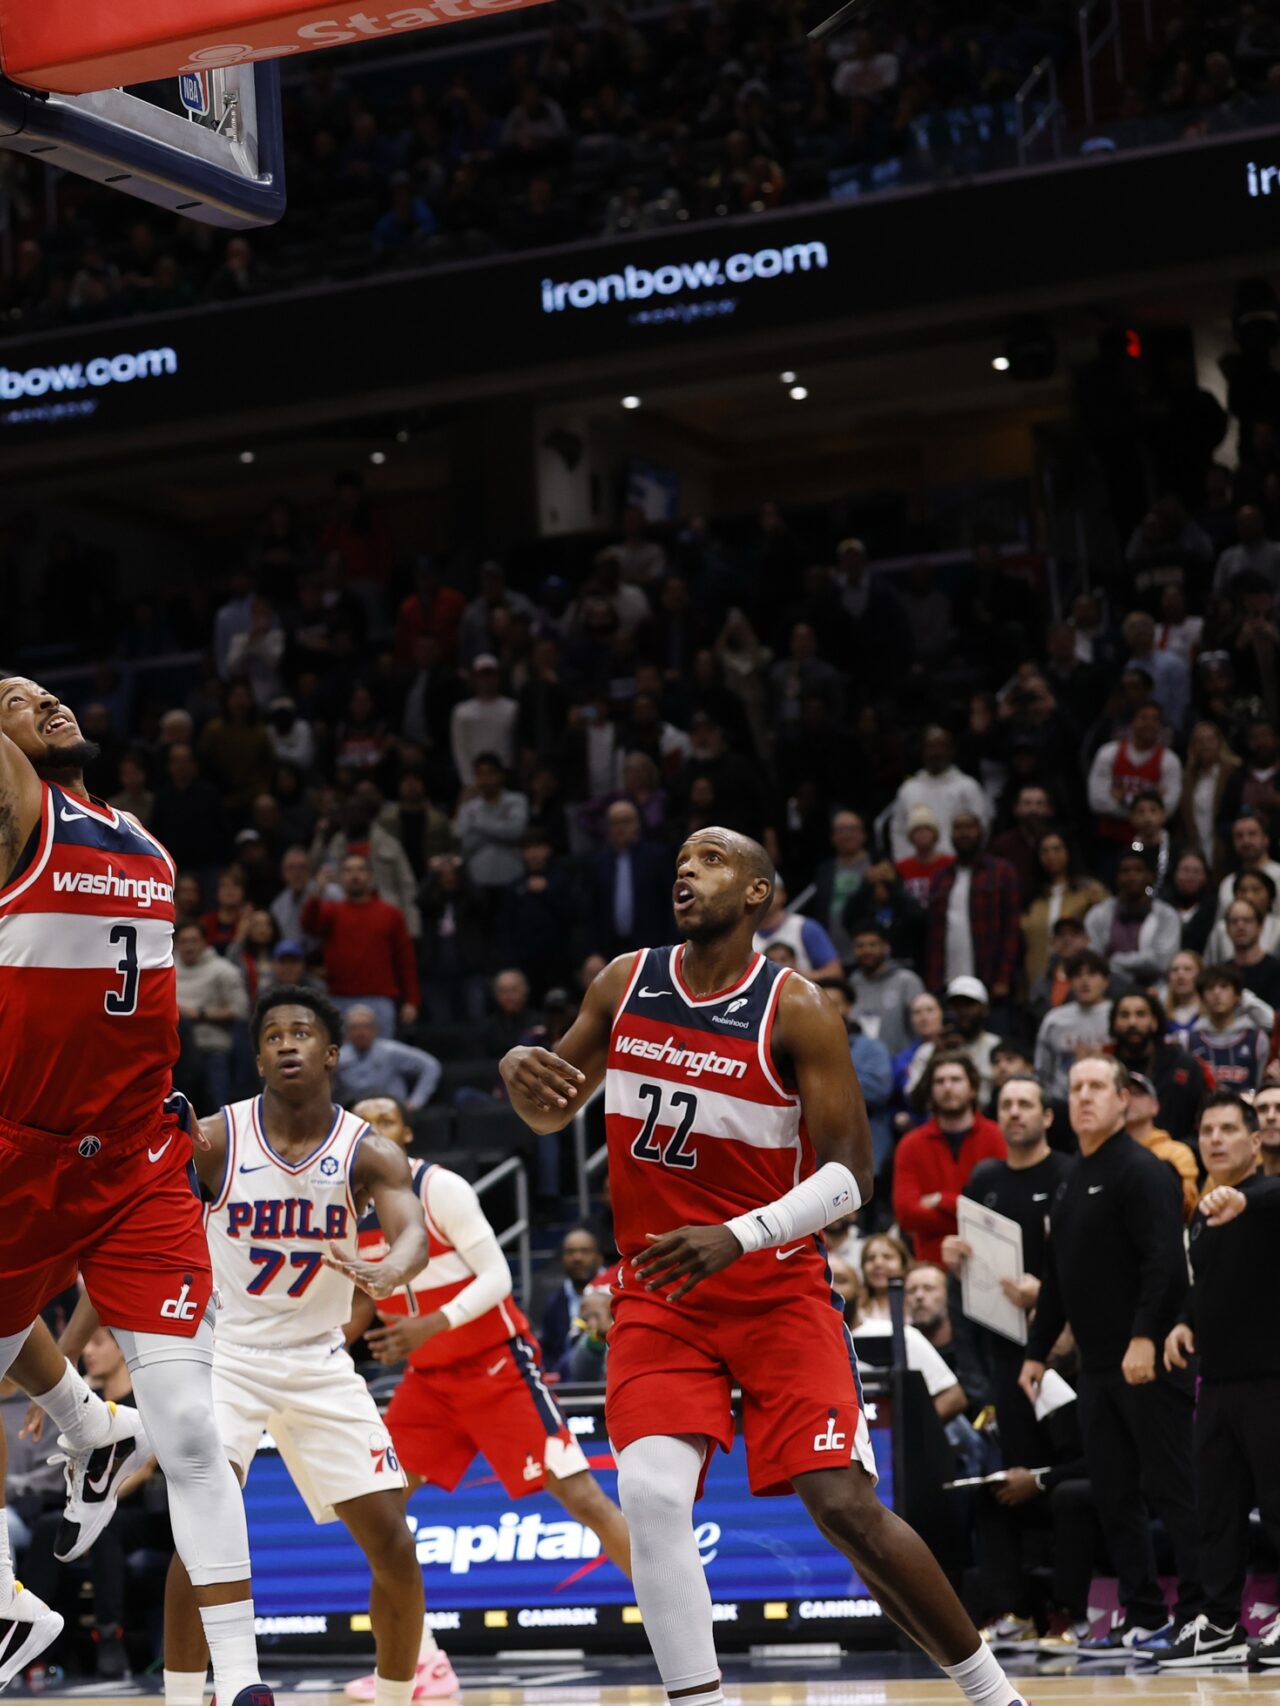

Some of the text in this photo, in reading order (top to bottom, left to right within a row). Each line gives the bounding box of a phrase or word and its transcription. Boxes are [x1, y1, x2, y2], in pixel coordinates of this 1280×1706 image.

[183, 75, 200, 104] NBA
[1246, 162, 1280, 197] ir
[542, 241, 829, 313] ironbow.com
[53, 864, 175, 907] washington
[104, 924, 140, 1016] 3
[711, 1015, 750, 1029] Robinhood
[615, 1036, 748, 1079] washington
[631, 1083, 698, 1170] 22
[226, 1198, 348, 1241] PHILA
[246, 1247, 328, 1298] 77
[160, 1283, 198, 1321] dc
[813, 1417, 846, 1452] dc
[369, 1446, 399, 1474] 76
